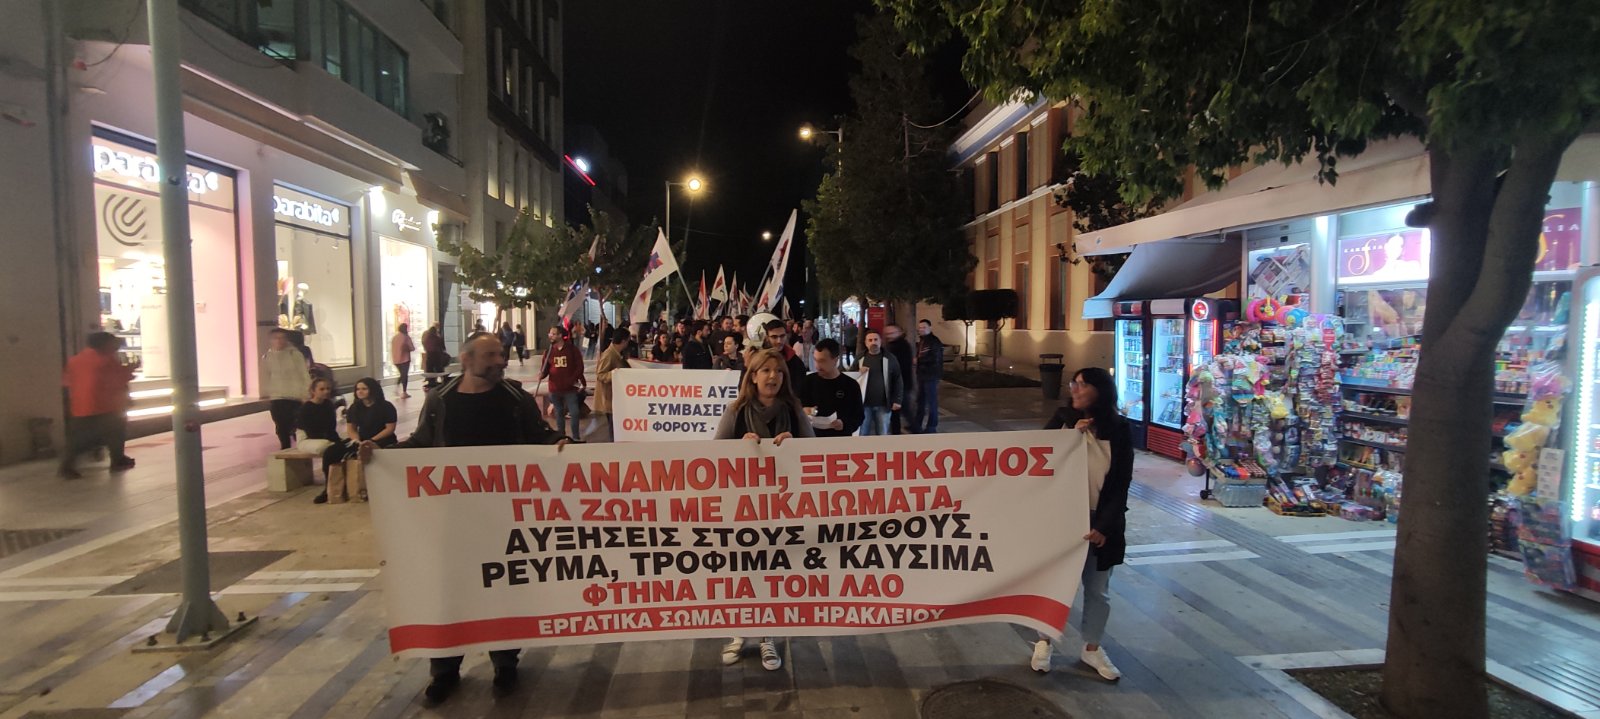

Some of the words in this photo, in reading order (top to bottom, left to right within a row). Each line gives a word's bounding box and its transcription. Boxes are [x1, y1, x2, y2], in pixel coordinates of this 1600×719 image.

[625, 383, 703, 399] ΘΕΛΟΥΜΕ
[622, 418, 648, 432] ΟΧΙ
[652, 421, 708, 433] ΦΟΡΟΥΣ
[406, 463, 552, 499] ΚΑΜΙΑ
[561, 455, 789, 493] ΑΝΑΜΟΝΗ,
[800, 446, 1055, 485] ΞΕΣΗΚΩΜΟΣ
[511, 497, 572, 523] ΓΙΑ
[580, 497, 658, 523] ΖΩΗ
[670, 496, 724, 523] ΜΕ
[734, 485, 962, 522] ΔΙΚΑΙΩΜΑΤΑ,
[505, 525, 682, 555] ΑΥΞΗΣΕΙΣ
[692, 524, 805, 548] ΣΤΟΥΣ
[481, 553, 619, 588] ΡΕΥΜΑ,
[630, 548, 792, 577] ΤΡΟΦΙΜΑ
[803, 546, 828, 570] &
[839, 543, 995, 573] ΚΑΥΣΙΜΑ
[582, 578, 697, 607] ΦΤΗΝΑ
[706, 575, 757, 600] ΓΙΑ
[764, 574, 830, 599] ΤΟΝ
[839, 573, 905, 599] ΛΑΟ
[538, 611, 653, 636] ΕΡΓΑΤΙΚΑ
[659, 607, 777, 627] ΣΩΜΑΤΕΙΑ
[783, 606, 806, 625] Ν.
[814, 606, 945, 625] ΗΡΑΚΛΕΙΟΥ
